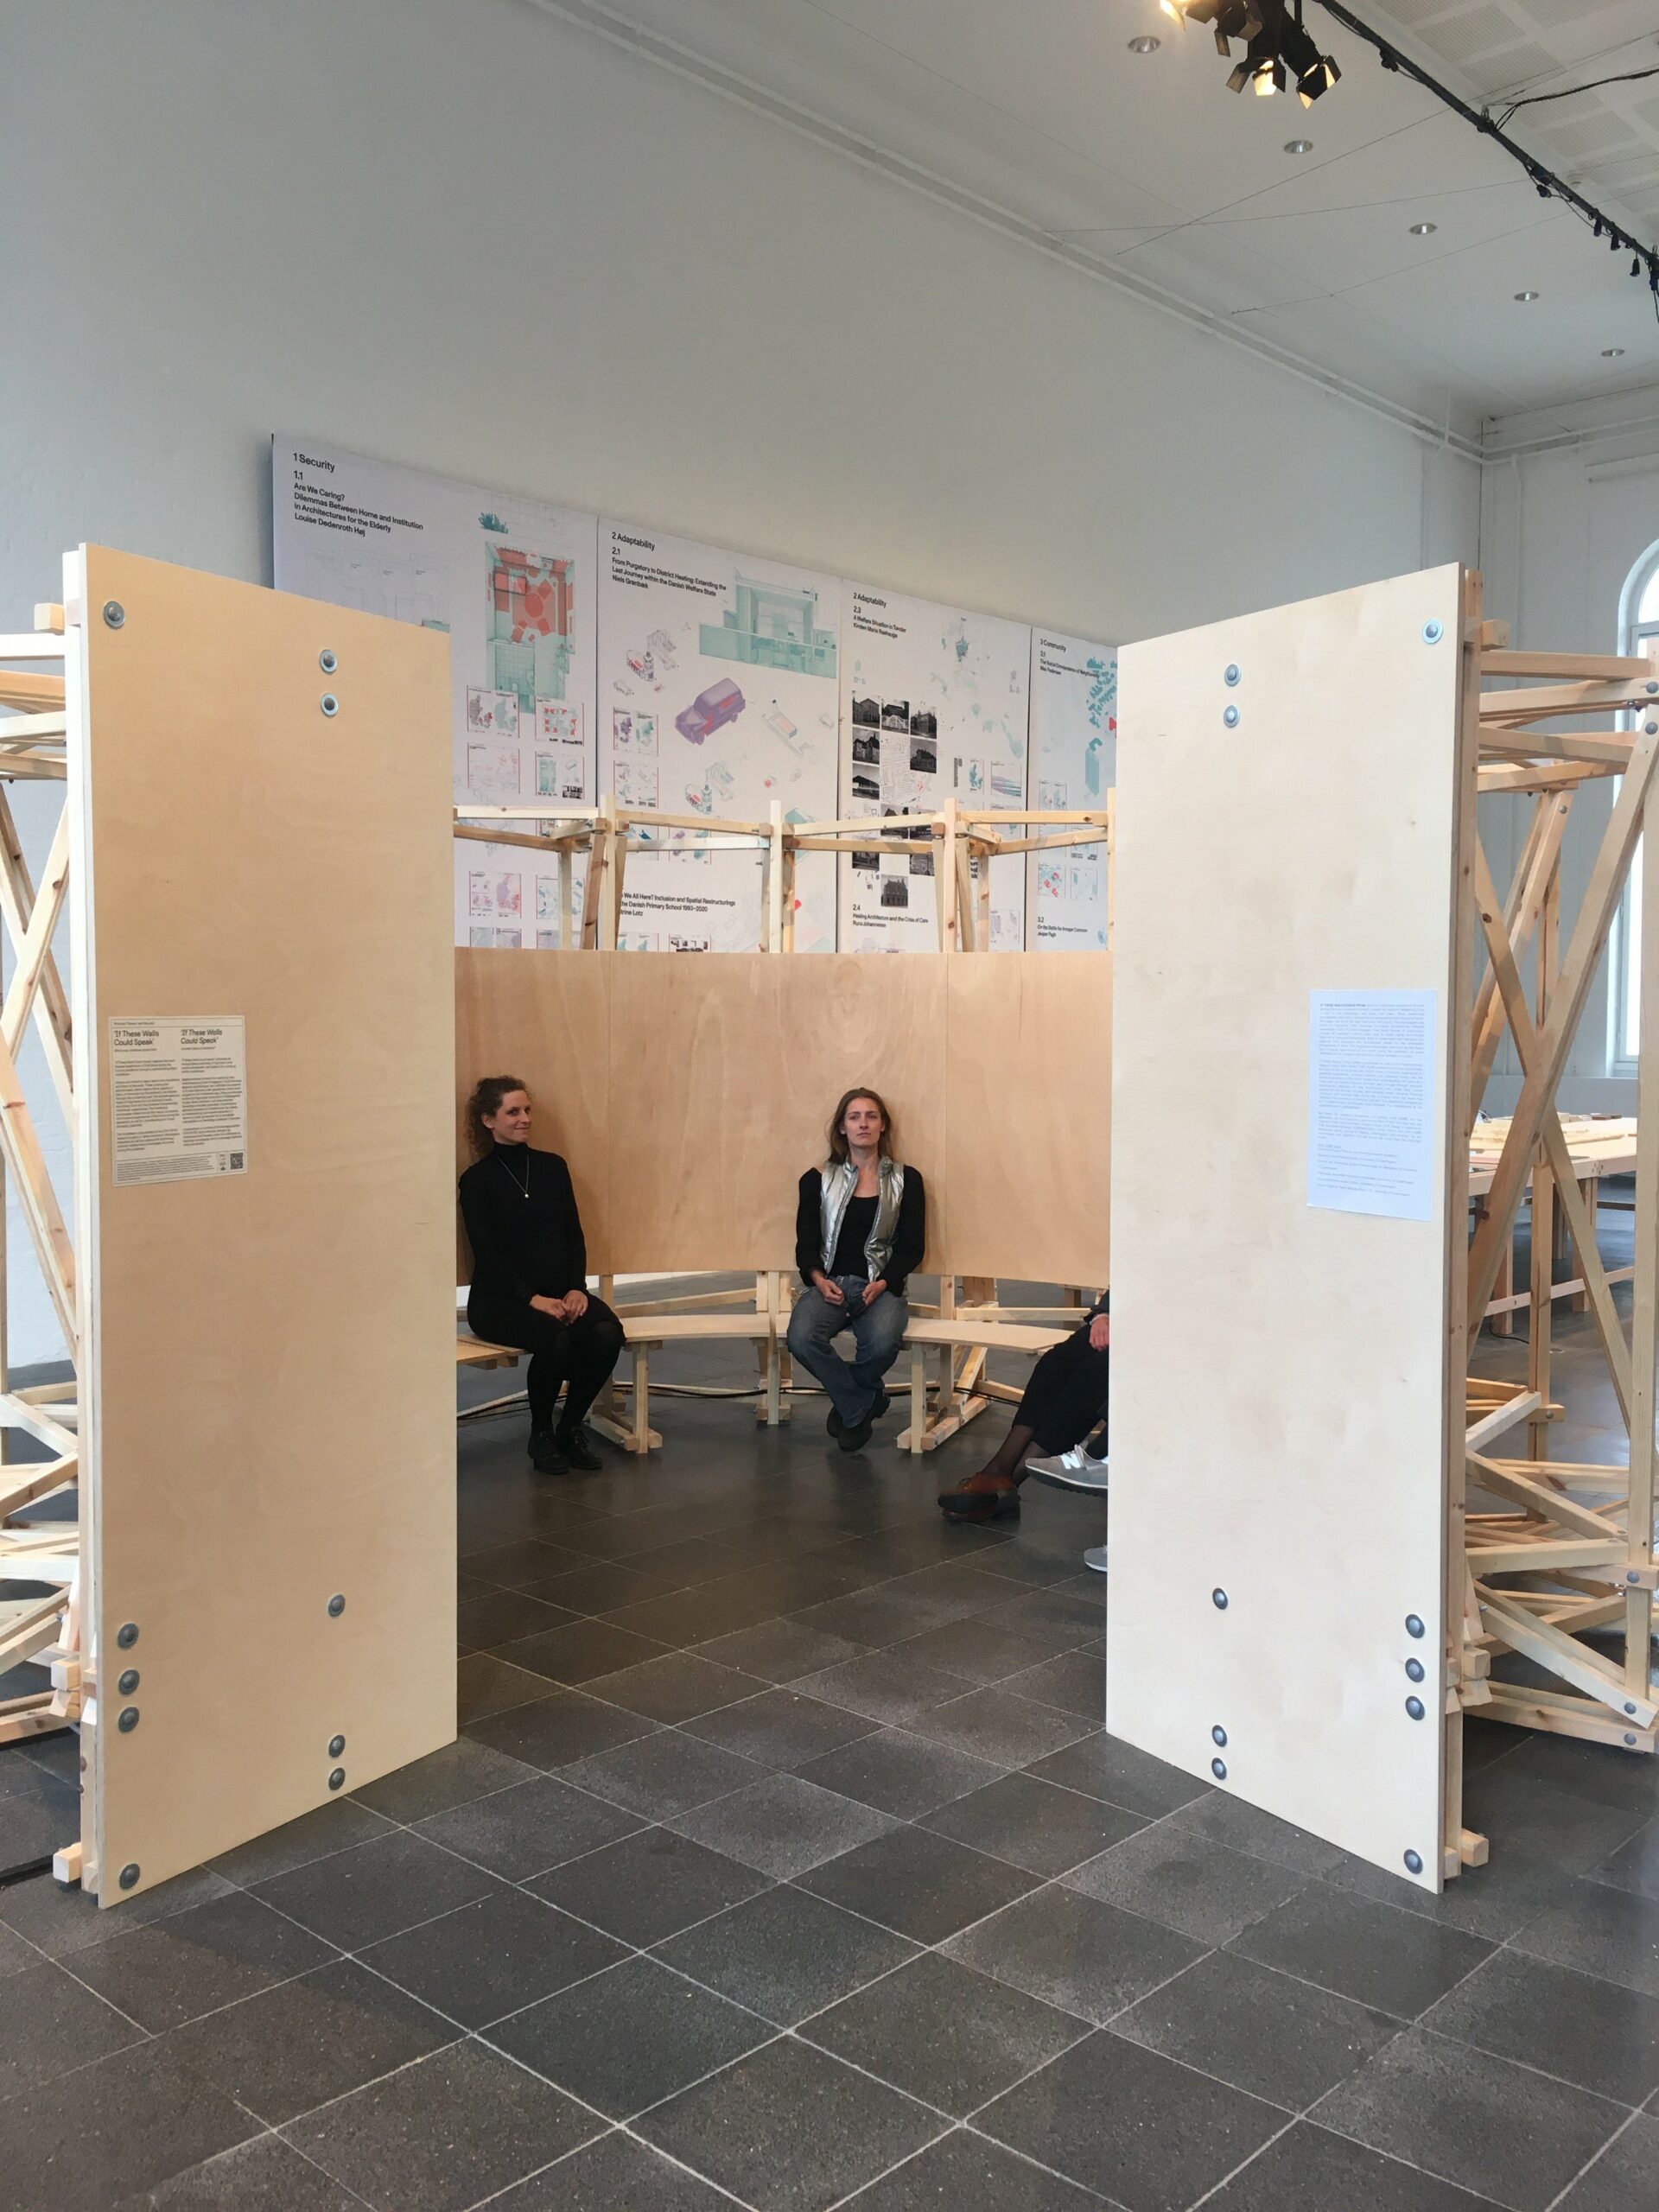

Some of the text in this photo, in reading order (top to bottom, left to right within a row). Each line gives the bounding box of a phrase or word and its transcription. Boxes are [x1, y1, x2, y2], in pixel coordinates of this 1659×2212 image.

[293, 452, 335, 473] 1 Security
[294, 470, 303, 480] 1.1
[294, 482, 345, 501] Are We Caring?
[294, 492, 423, 530] Dilemmas Between Home and Institution
[295, 502, 301, 511] in
[302, 504, 346, 521] Architectures
[347, 515, 357, 524] for
[370, 520, 391, 533] Elderly
[295, 512, 365, 537] Louise Dedenroth Høj
[617, 533, 655, 551] Adaptability
[612, 546, 620, 555] 2.1
[612, 556, 626, 566] From
[626, 560, 650, 573] Purgatory
[657, 569, 674, 579] District
[695, 578, 718, 590] Extending
[612, 574, 625, 583] Niels
[612, 565, 623, 574] Last
[623, 569, 644, 580] Journey
[644, 575, 659, 583] within
[668, 580, 684, 589] Danish
[685, 584, 703, 594] Welfare
[703, 588, 716, 597] State
[857, 594, 887, 608] Adaptability
[872, 620, 888, 628] Situation
[1044, 639, 1066, 652] Community
[646, 902, 664, 911] Primary
[702, 898, 735, 907] Restructurings
[114, 1038, 133, 1046] Could
[1060, 1453, 1081, 1469] N
